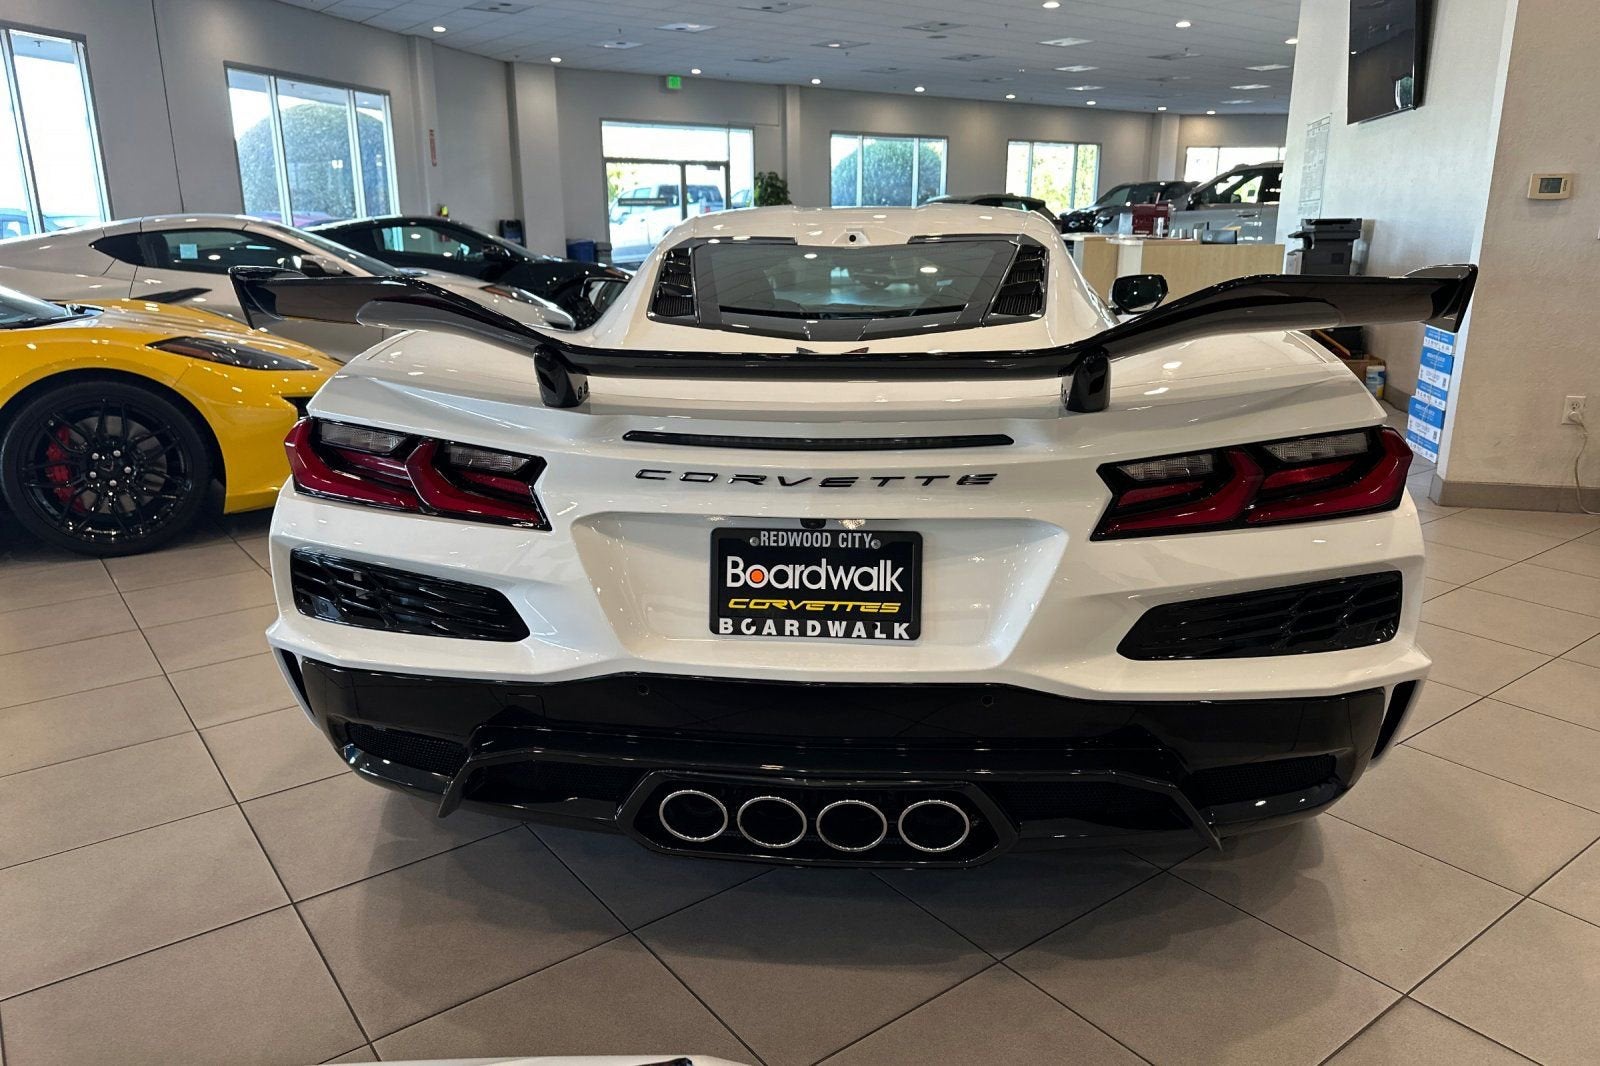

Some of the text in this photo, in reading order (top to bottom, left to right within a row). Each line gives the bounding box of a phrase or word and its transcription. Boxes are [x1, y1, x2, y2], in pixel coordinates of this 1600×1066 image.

[635, 468, 998, 488] CORVETTE
[760, 530, 873, 549] REDWOOD CITY
[726, 555, 904, 593] Boardwalk
[728, 598, 902, 613] CORVETTES
[718, 617, 911, 640] BOARDWALK
